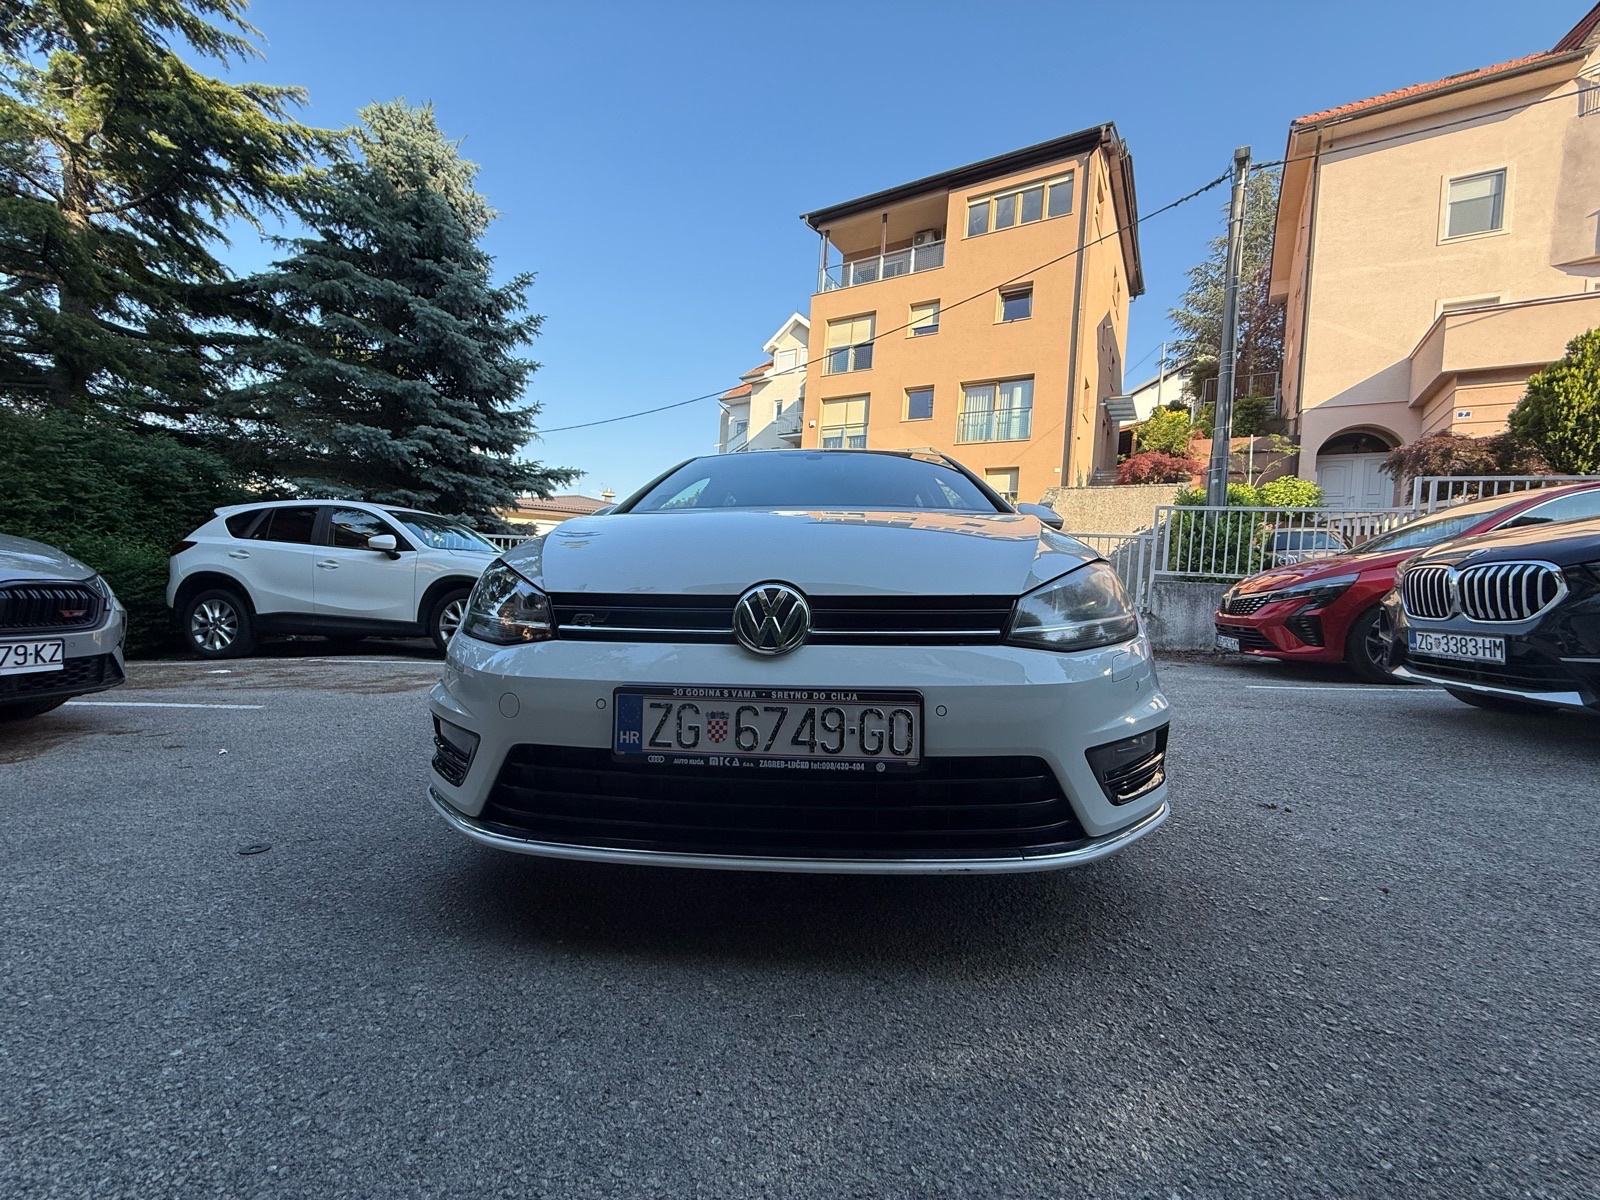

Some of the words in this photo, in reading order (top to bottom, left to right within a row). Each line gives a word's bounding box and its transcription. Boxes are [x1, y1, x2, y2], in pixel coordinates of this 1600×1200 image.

[0, 643, 61, 667] 79-KZ
[1417, 633, 1433, 651] ZG
[1441, 635, 1504, 660] 3383-HM
[672, 688, 684, 696] 30
[686, 688, 721, 697] GODINA
[723, 689, 730, 698] S
[732, 689, 758, 698] VAMA
[771, 690, 808, 700] SRETNO
[813, 692, 826, 700] DO
[831, 693, 858, 701] CILJA
[619, 730, 640, 744] HR
[649, 703, 701, 749] ZG
[735, 705, 914, 757] 6749-GO
